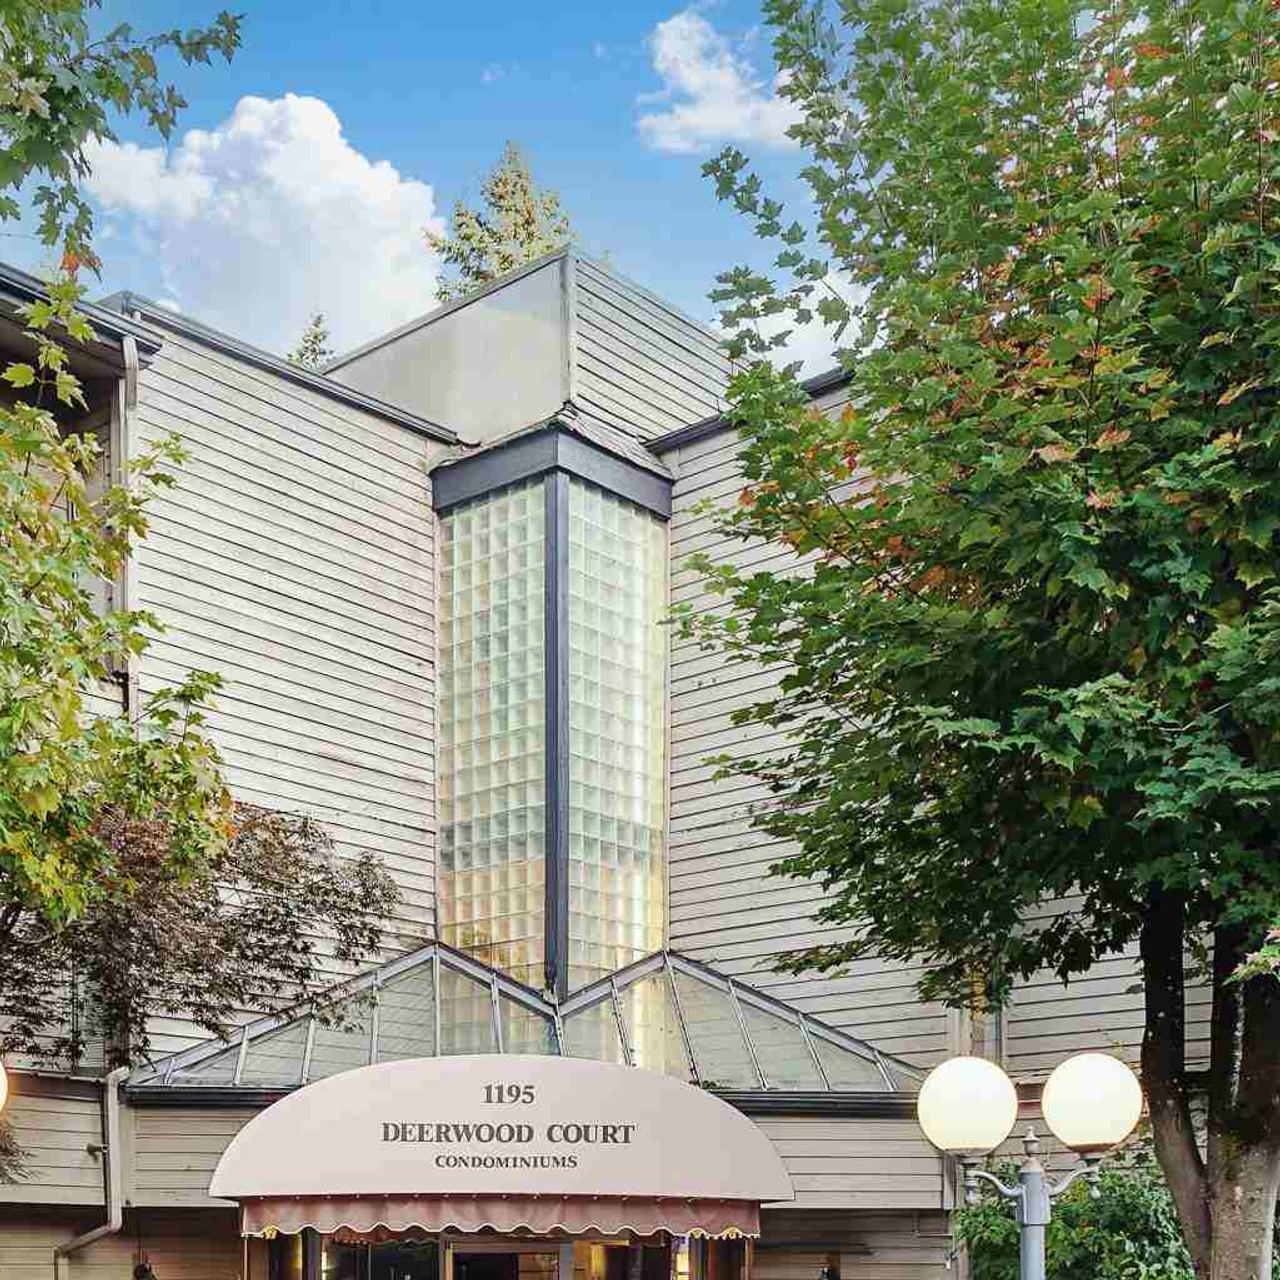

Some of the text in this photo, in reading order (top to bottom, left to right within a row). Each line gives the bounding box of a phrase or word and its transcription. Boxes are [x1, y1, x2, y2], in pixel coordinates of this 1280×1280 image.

[483, 1084, 535, 1105] 1195
[381, 1122, 638, 1144] DEERWOOD COURT
[435, 1154, 578, 1169] CONDOMINIUMS
